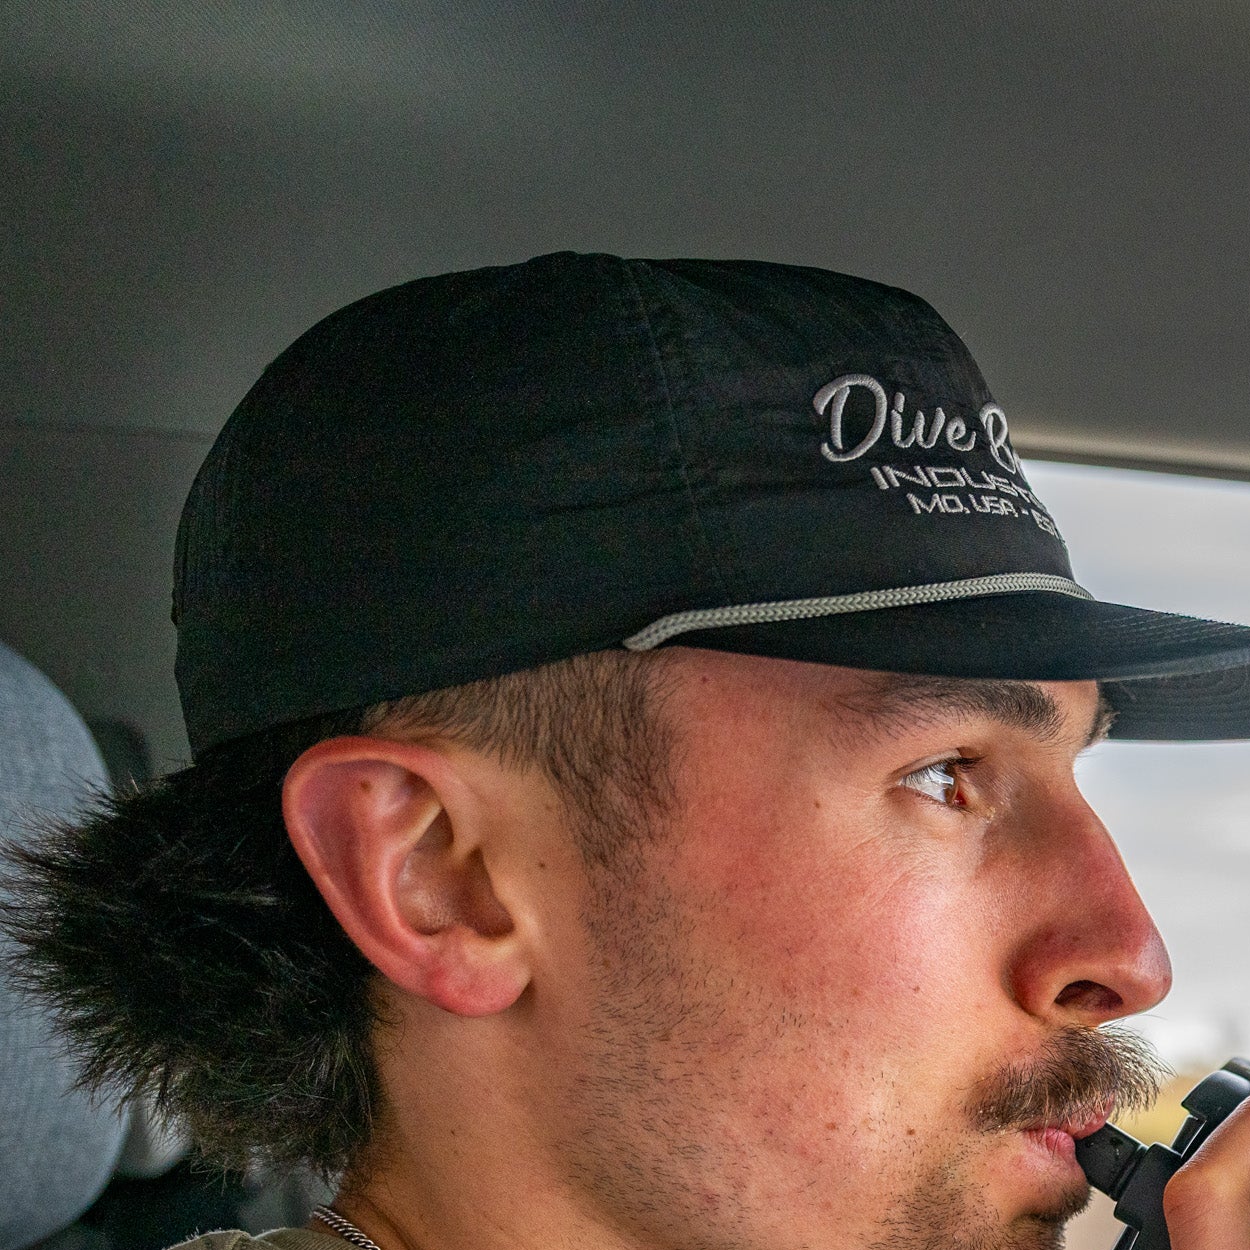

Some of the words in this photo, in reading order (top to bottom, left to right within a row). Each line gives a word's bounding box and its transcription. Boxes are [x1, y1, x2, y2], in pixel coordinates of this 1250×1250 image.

[814, 374, 976, 463] Dive
[980, 402, 1026, 480] B
[870, 465, 1046, 515] INDUST
